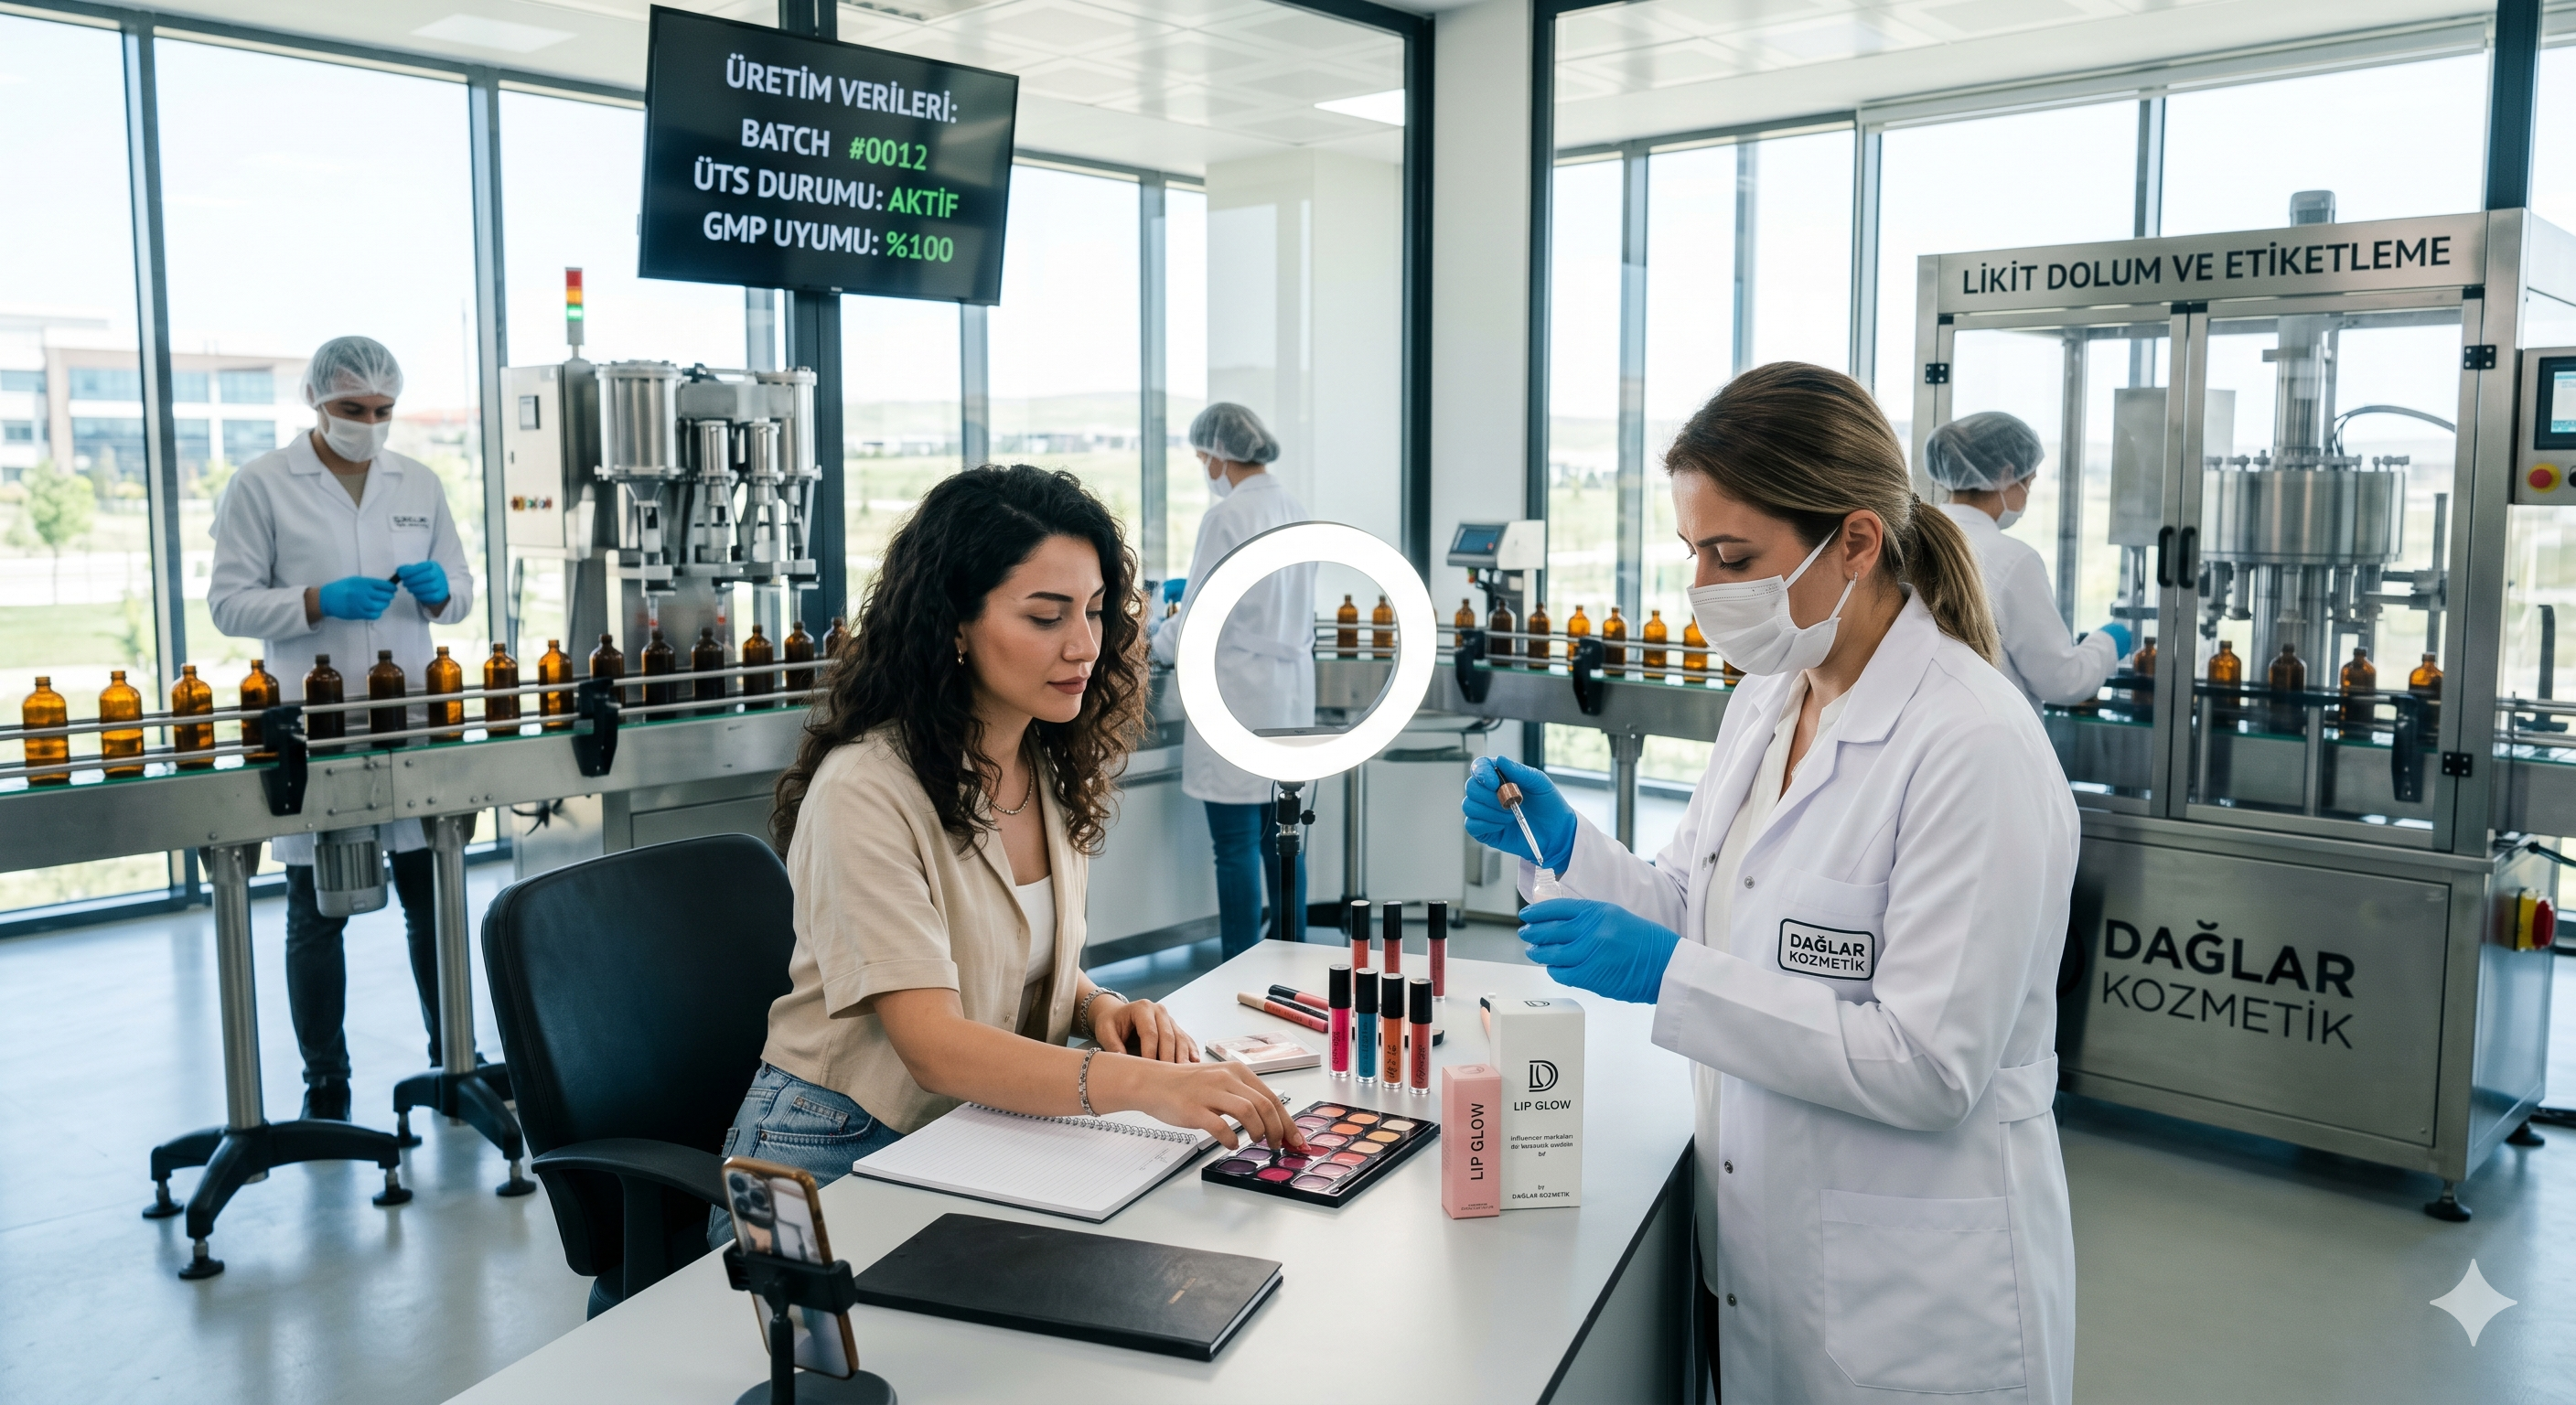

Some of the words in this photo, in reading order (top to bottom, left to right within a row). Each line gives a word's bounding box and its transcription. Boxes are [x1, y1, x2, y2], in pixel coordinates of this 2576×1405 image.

[725, 53, 832, 102] ÜRETİM
[839, 77, 958, 123] VERİLERİ:
[741, 118, 831, 157] BATCH
[849, 136, 928, 171] #0012
[693, 156, 750, 195] ÜTS
[757, 169, 884, 211] DURUMU:
[887, 186, 960, 219] AKTİF
[703, 211, 767, 244] GMP
[774, 220, 879, 256] UYUMU:
[886, 231, 954, 263] %100
[1963, 260, 2038, 295] LİKİT
[2047, 256, 2161, 291] DOLUM
[2172, 252, 2214, 282] VE
[2226, 235, 2451, 280] ETİKETLEME
[1789, 950, 1865, 972] KOZMETİK
[1790, 933, 1865, 958] DAĞLAR
[2104, 918, 2355, 999] DAĞLAR
[2103, 971, 2354, 1049] KOZMETİK
[1470, 1102, 1485, 1152] GLOW
[1514, 1101, 1532, 1111] LIP
[1535, 1099, 1572, 1110] GLOW
[1470, 1156, 1484, 1181] LIP
